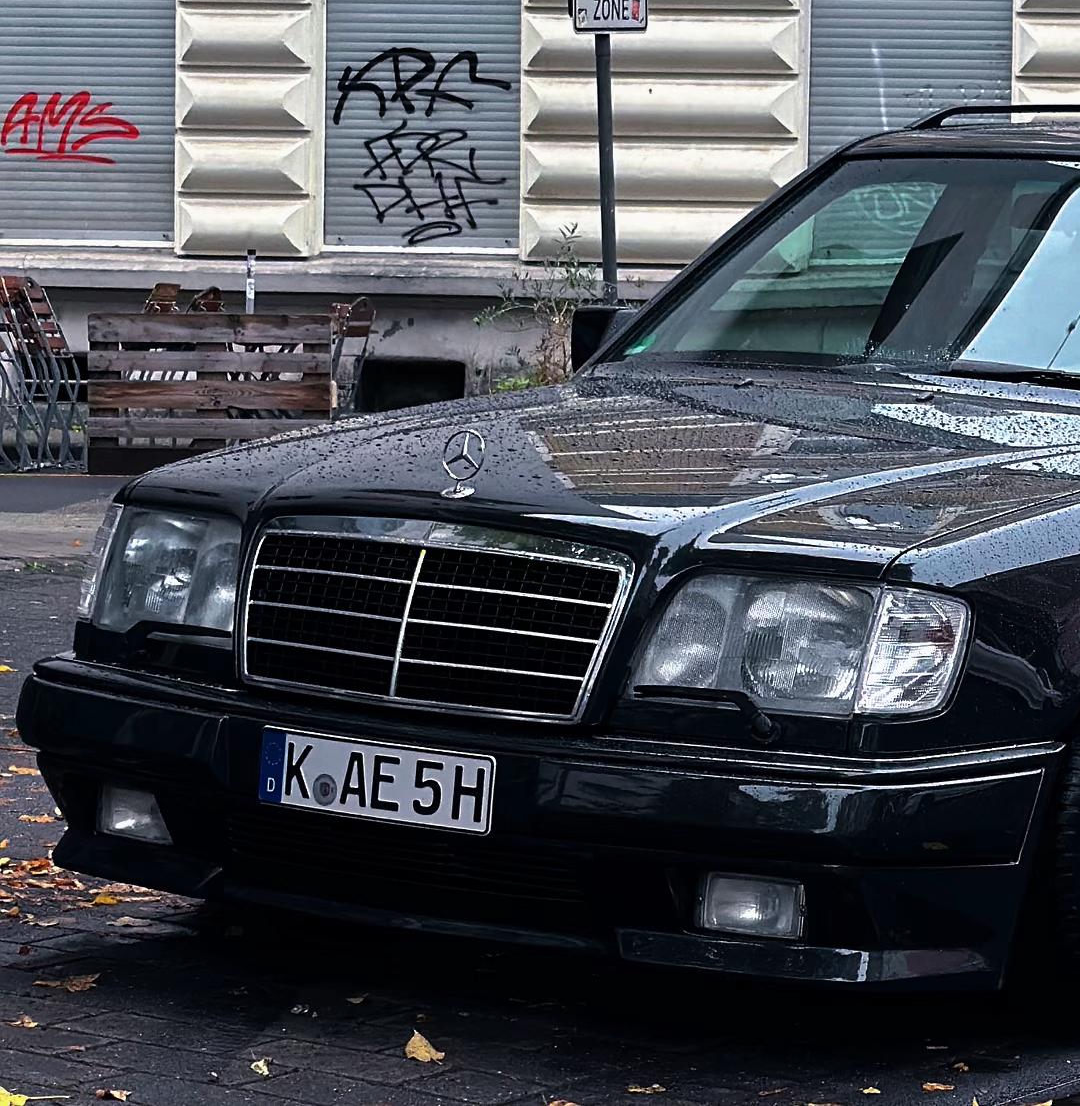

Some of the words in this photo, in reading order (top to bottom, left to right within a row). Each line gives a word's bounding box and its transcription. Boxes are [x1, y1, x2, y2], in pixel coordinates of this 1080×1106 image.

[266, 777, 276, 793] D
[284, 741, 314, 799] K
[339, 751, 401, 813] AE
[412, 758, 486, 824] 5H
